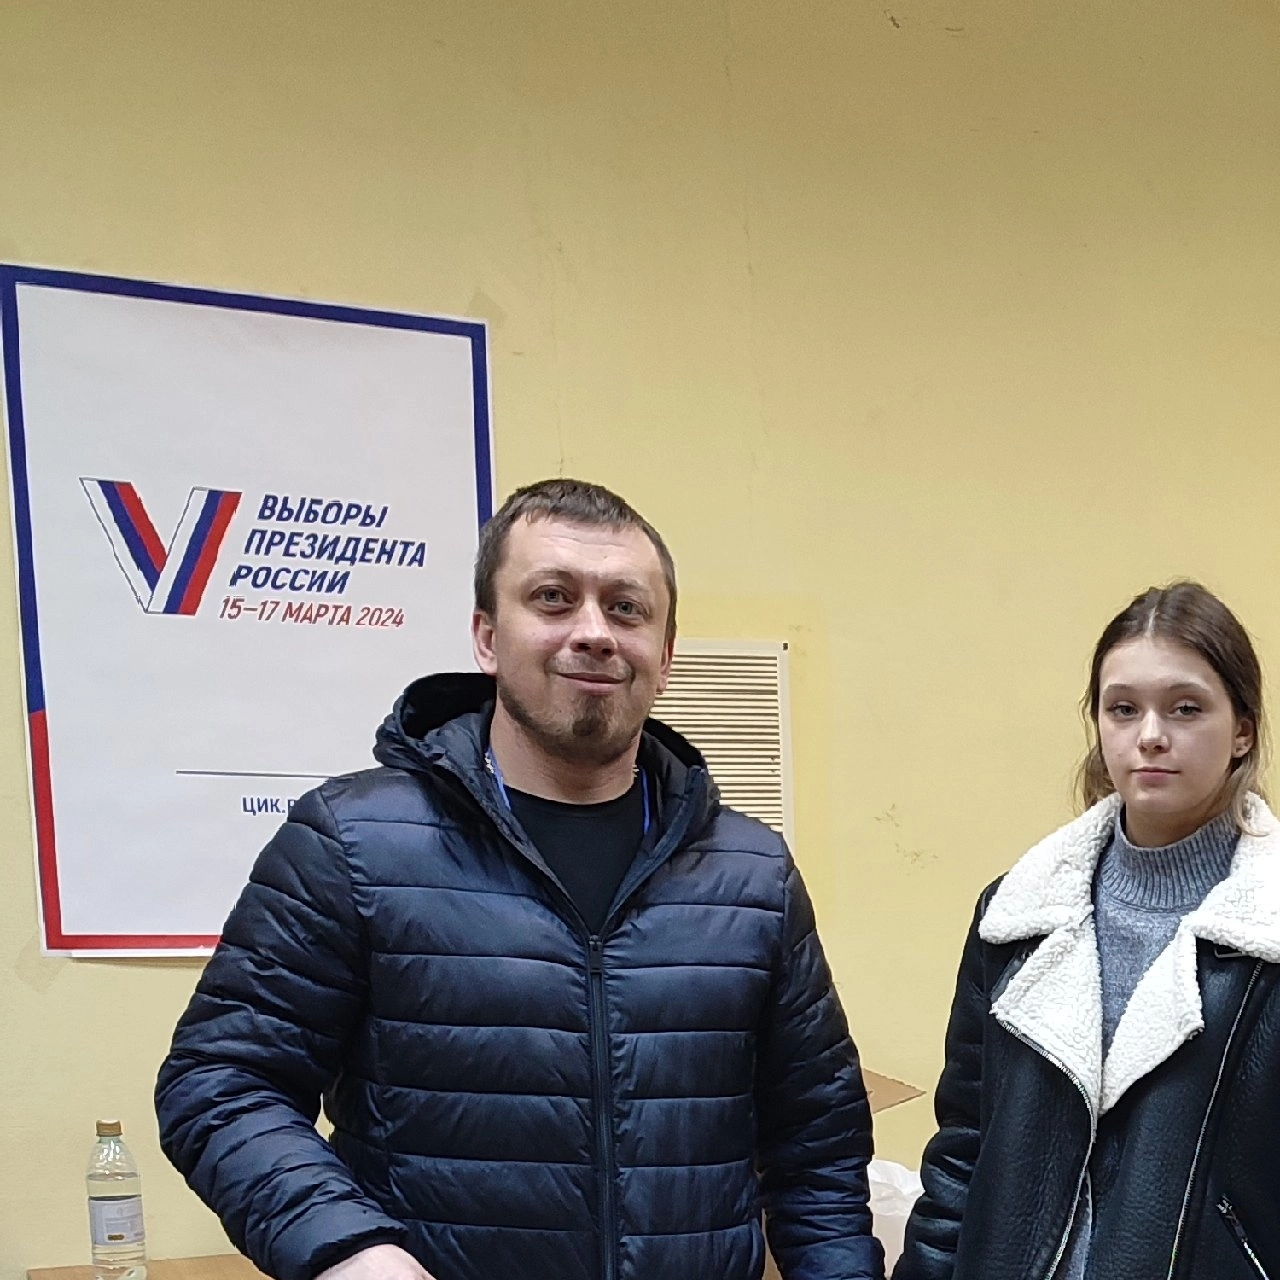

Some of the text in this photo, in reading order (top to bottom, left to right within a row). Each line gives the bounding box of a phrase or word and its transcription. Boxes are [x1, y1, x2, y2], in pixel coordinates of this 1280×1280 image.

[257, 494, 389, 528] ВЫБОРЫ
[243, 528, 427, 567] ПРЕЗИДЕНТА
[229, 564, 351, 595] РОССИИ
[281, 601, 353, 626] МАРТА
[356, 606, 405, 628] 2024
[242, 797, 297, 816] ЦИК.Р
